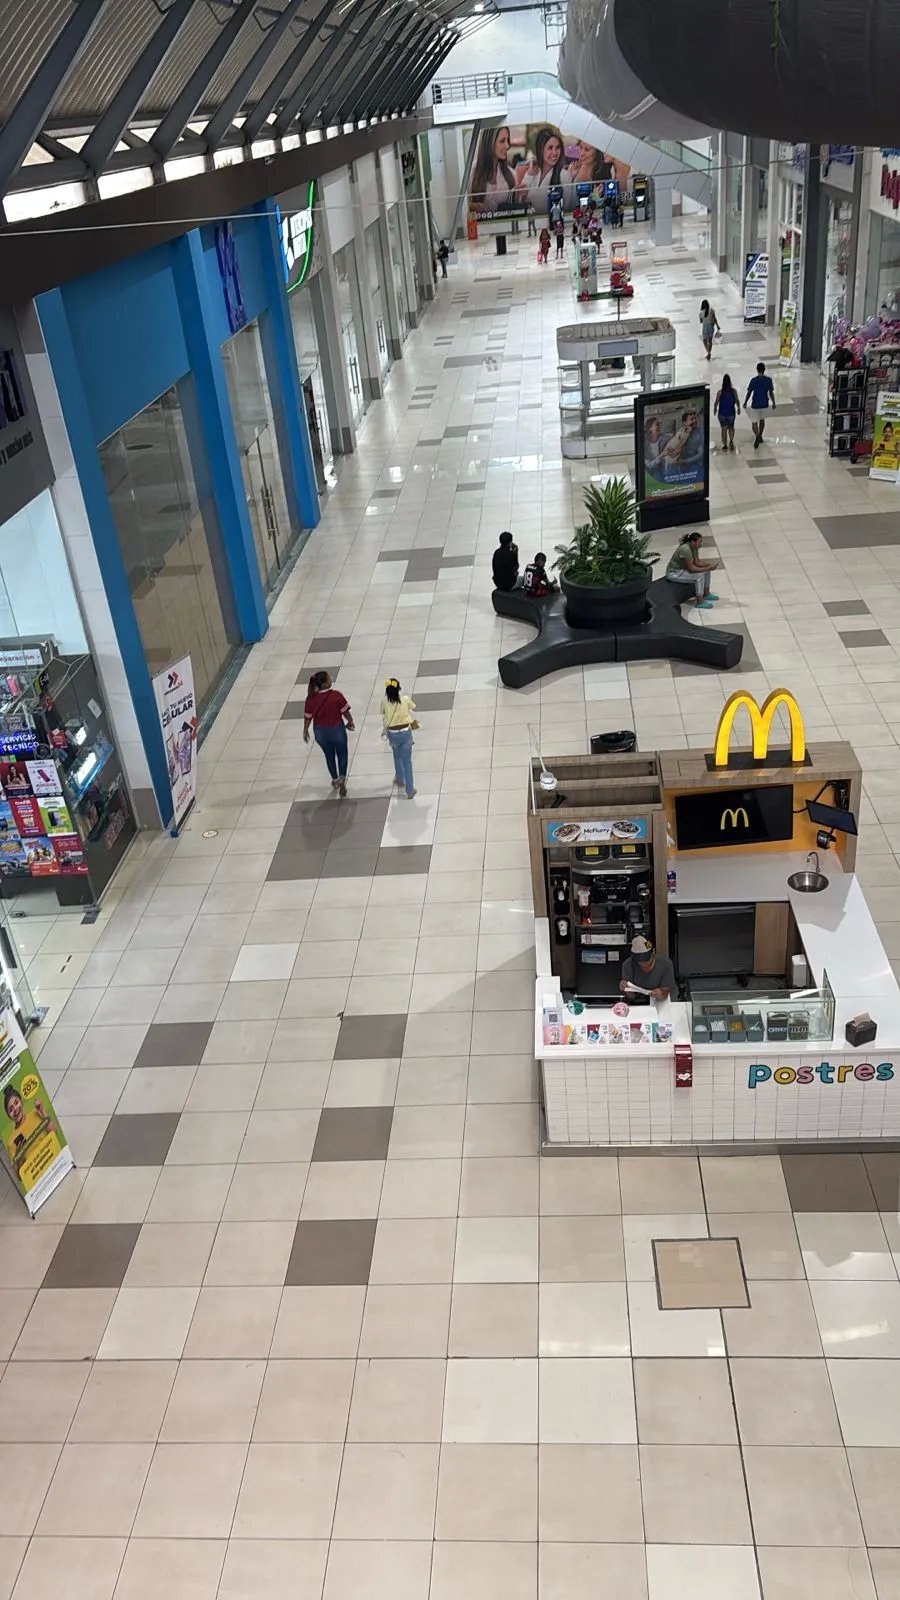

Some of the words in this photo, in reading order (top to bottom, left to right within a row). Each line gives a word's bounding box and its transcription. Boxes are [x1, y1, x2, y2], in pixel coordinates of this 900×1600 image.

[0, 655, 35, 664] eparación
[178, 692, 193, 706] NUEVO
[748, 1062, 894, 1088] postres
[22, 1079, 38, 1095] 20%
